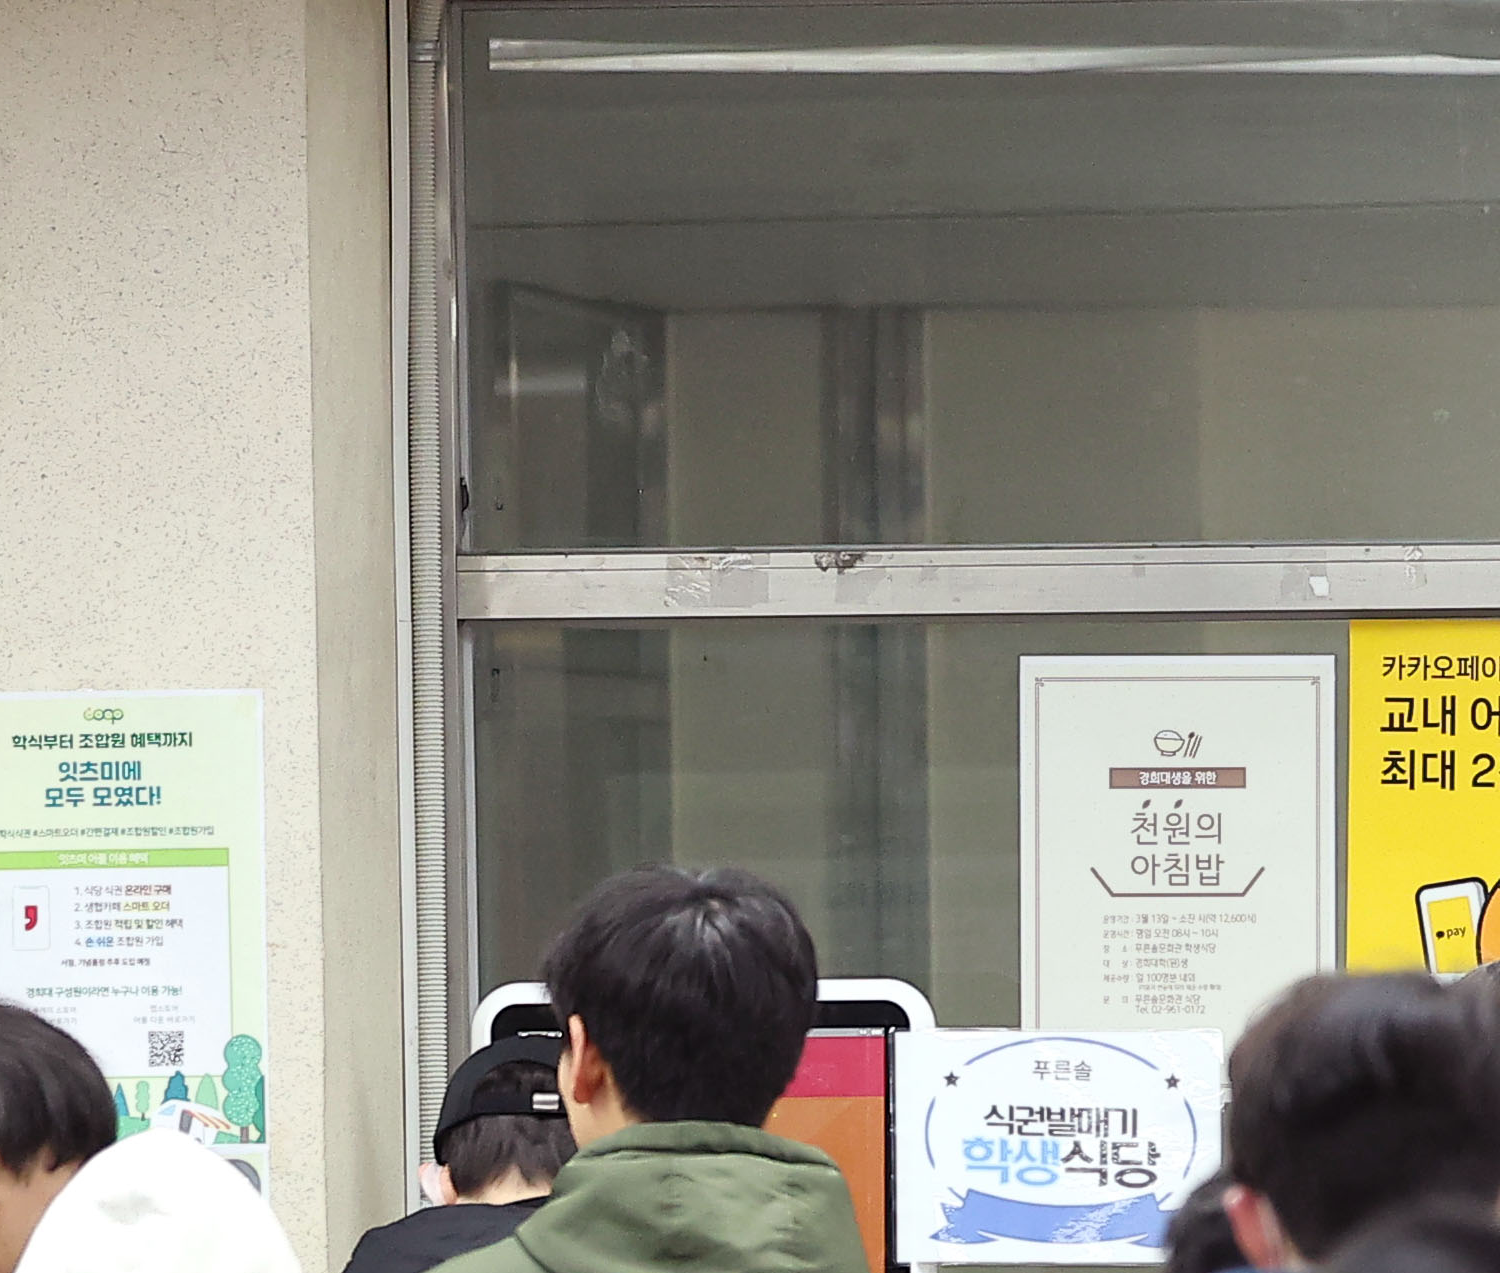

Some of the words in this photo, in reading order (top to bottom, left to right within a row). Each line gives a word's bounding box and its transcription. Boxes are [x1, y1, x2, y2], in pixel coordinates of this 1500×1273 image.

[1380, 695, 1456, 736] 교내
[12, 734, 73, 750] 학식부터
[79, 733, 125, 748] 조합원
[131, 732, 192, 747] 혜택까지
[59, 761, 141, 782] 잇츠미에
[1195, 770, 1217, 786] 위한
[1381, 750, 1455, 791] 최대
[45, 787, 85, 807] 모두
[93, 786, 161, 807] 모였다!
[1131, 813, 1221, 845] 천원의
[1131, 853, 1225, 886] 아침밥
[1446, 927, 1466, 939] pay
[1033, 1060, 1092, 1081] 푸른솔
[984, 1105, 1137, 1138] 식권발매기
[964, 1135, 1161, 1190] 학생식당
